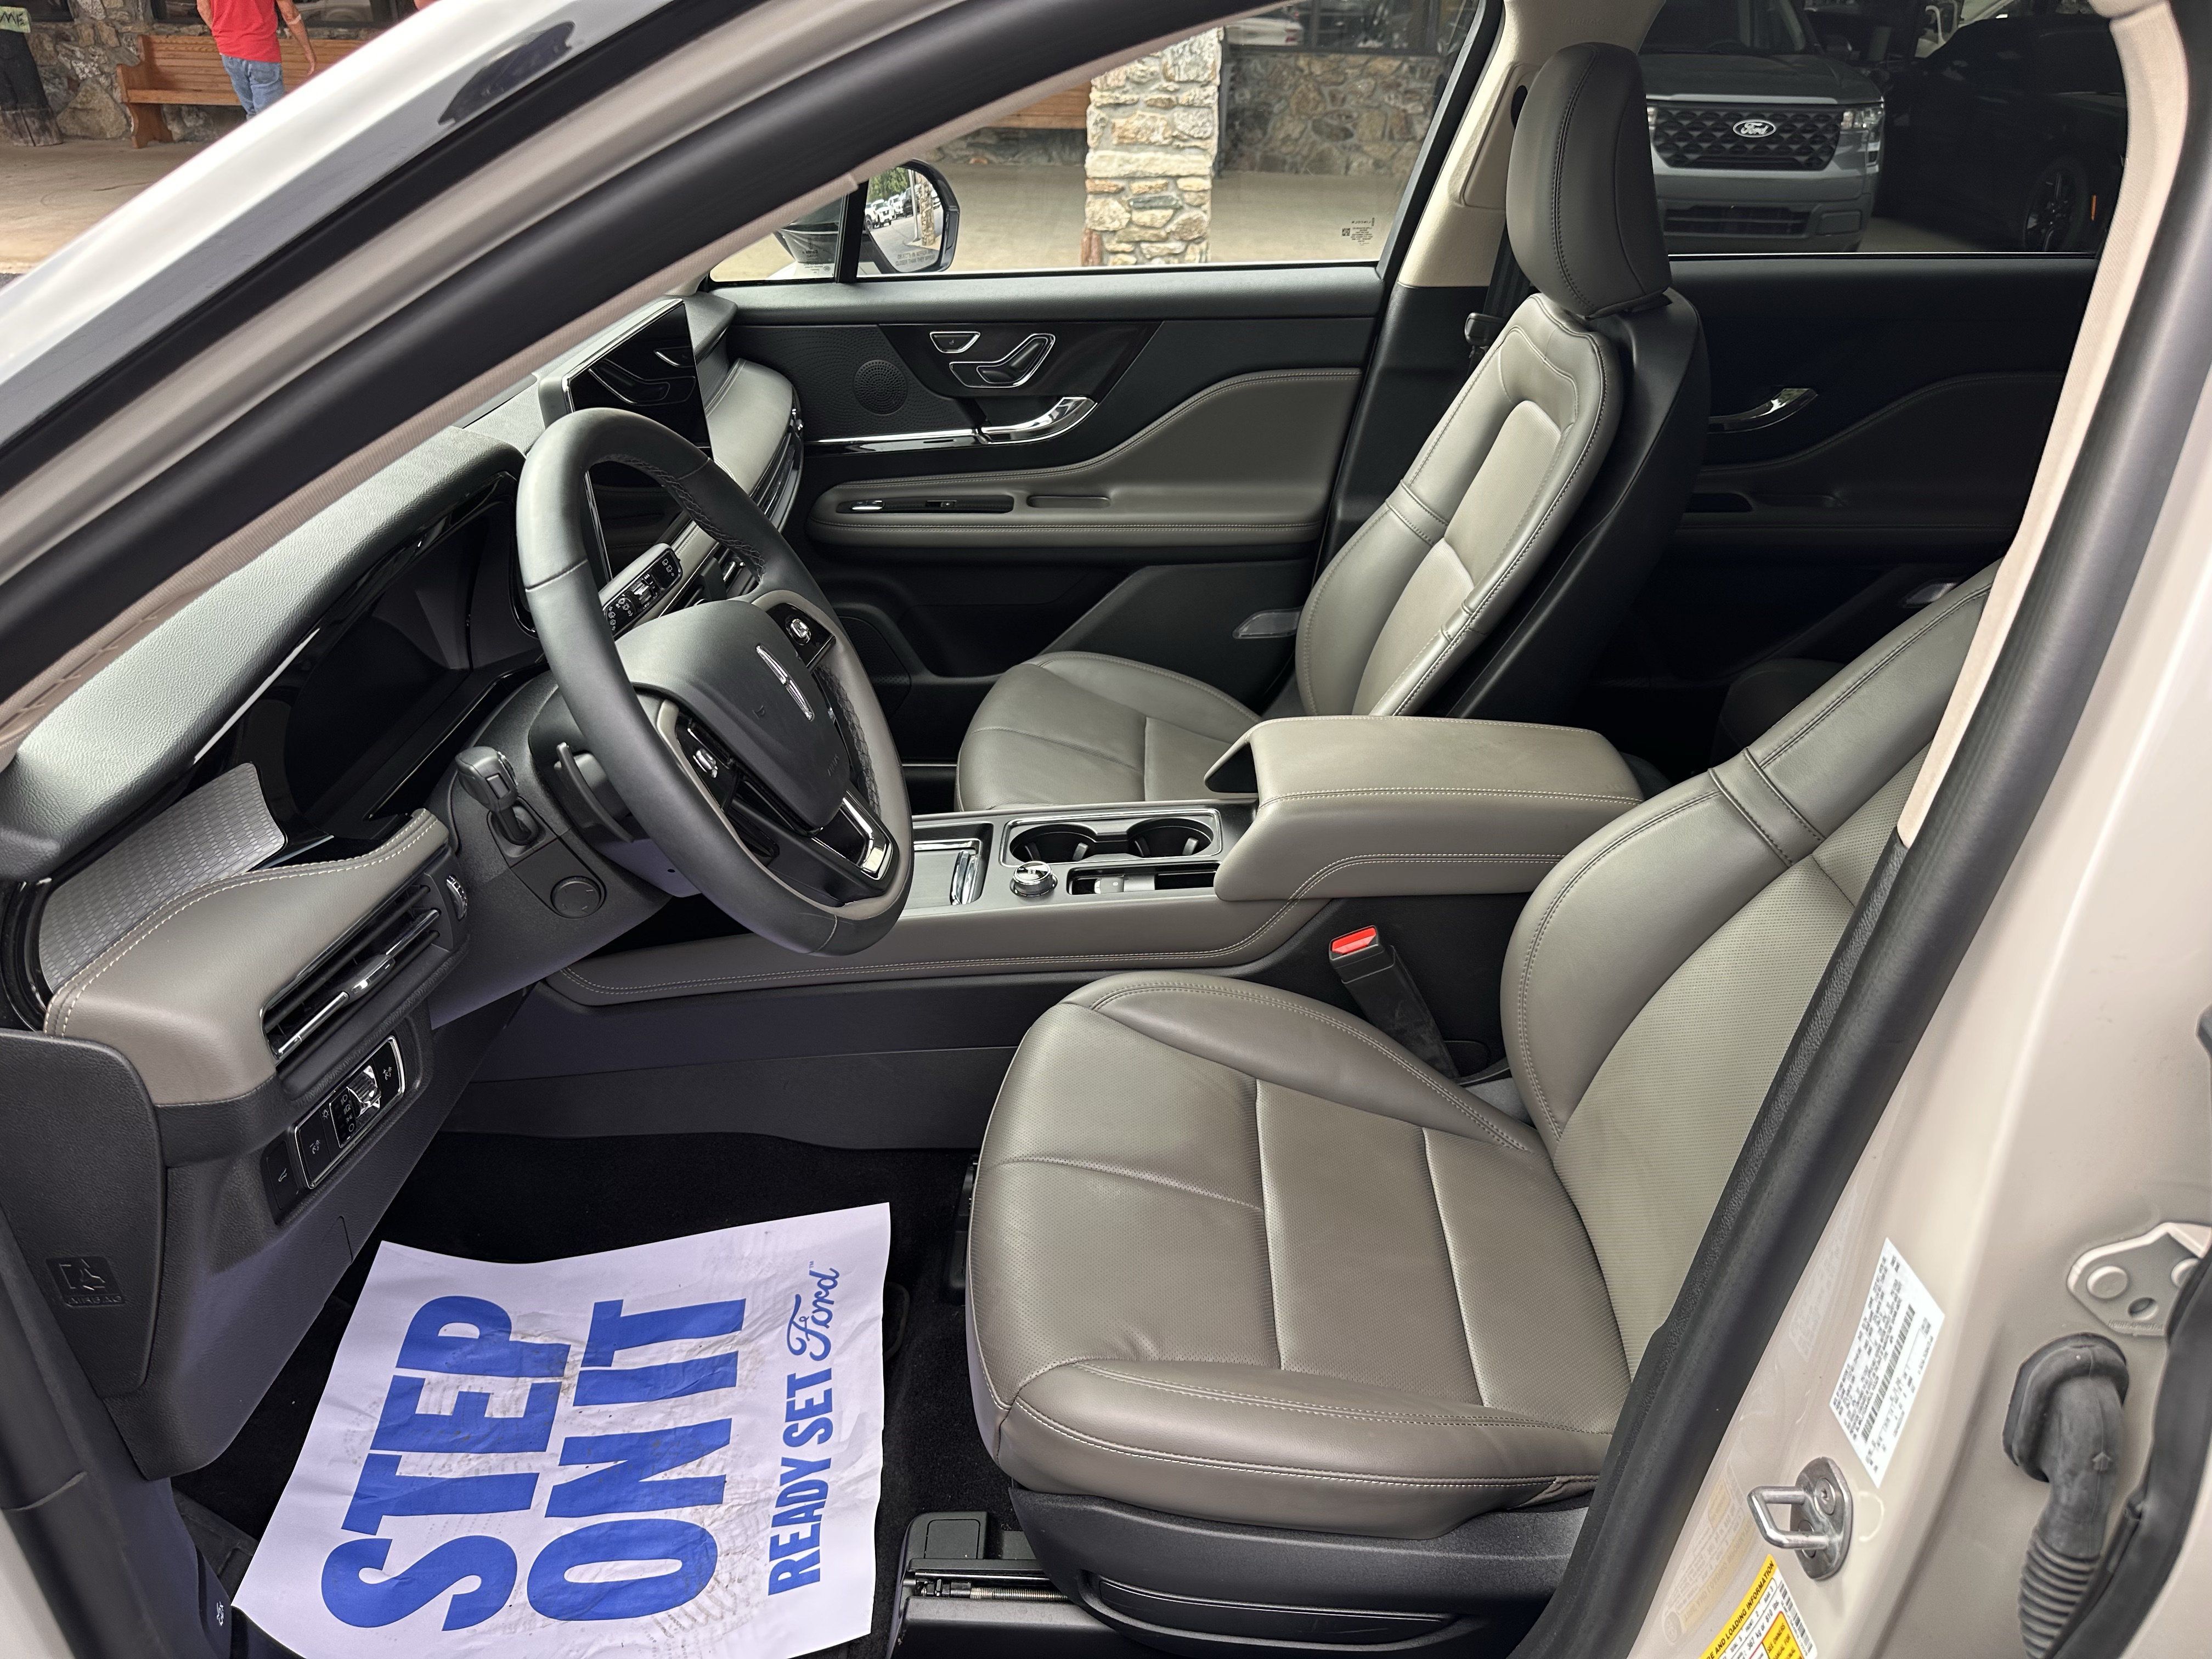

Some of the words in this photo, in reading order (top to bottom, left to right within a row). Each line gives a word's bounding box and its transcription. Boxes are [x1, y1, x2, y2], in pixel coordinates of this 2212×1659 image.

[573, 1298, 746, 1406] IT
[787, 1267, 839, 1362] Ford
[782, 1373, 833, 1444] SET
[321, 1295, 571, 1631] STEP
[527, 1418, 732, 1622] ON
[768, 1457, 831, 1595] READY
[1716, 1638, 1726, 1655] AND
[1725, 1608, 1747, 1640] LOADING
[1746, 1560, 1774, 1611] INFORMATION
